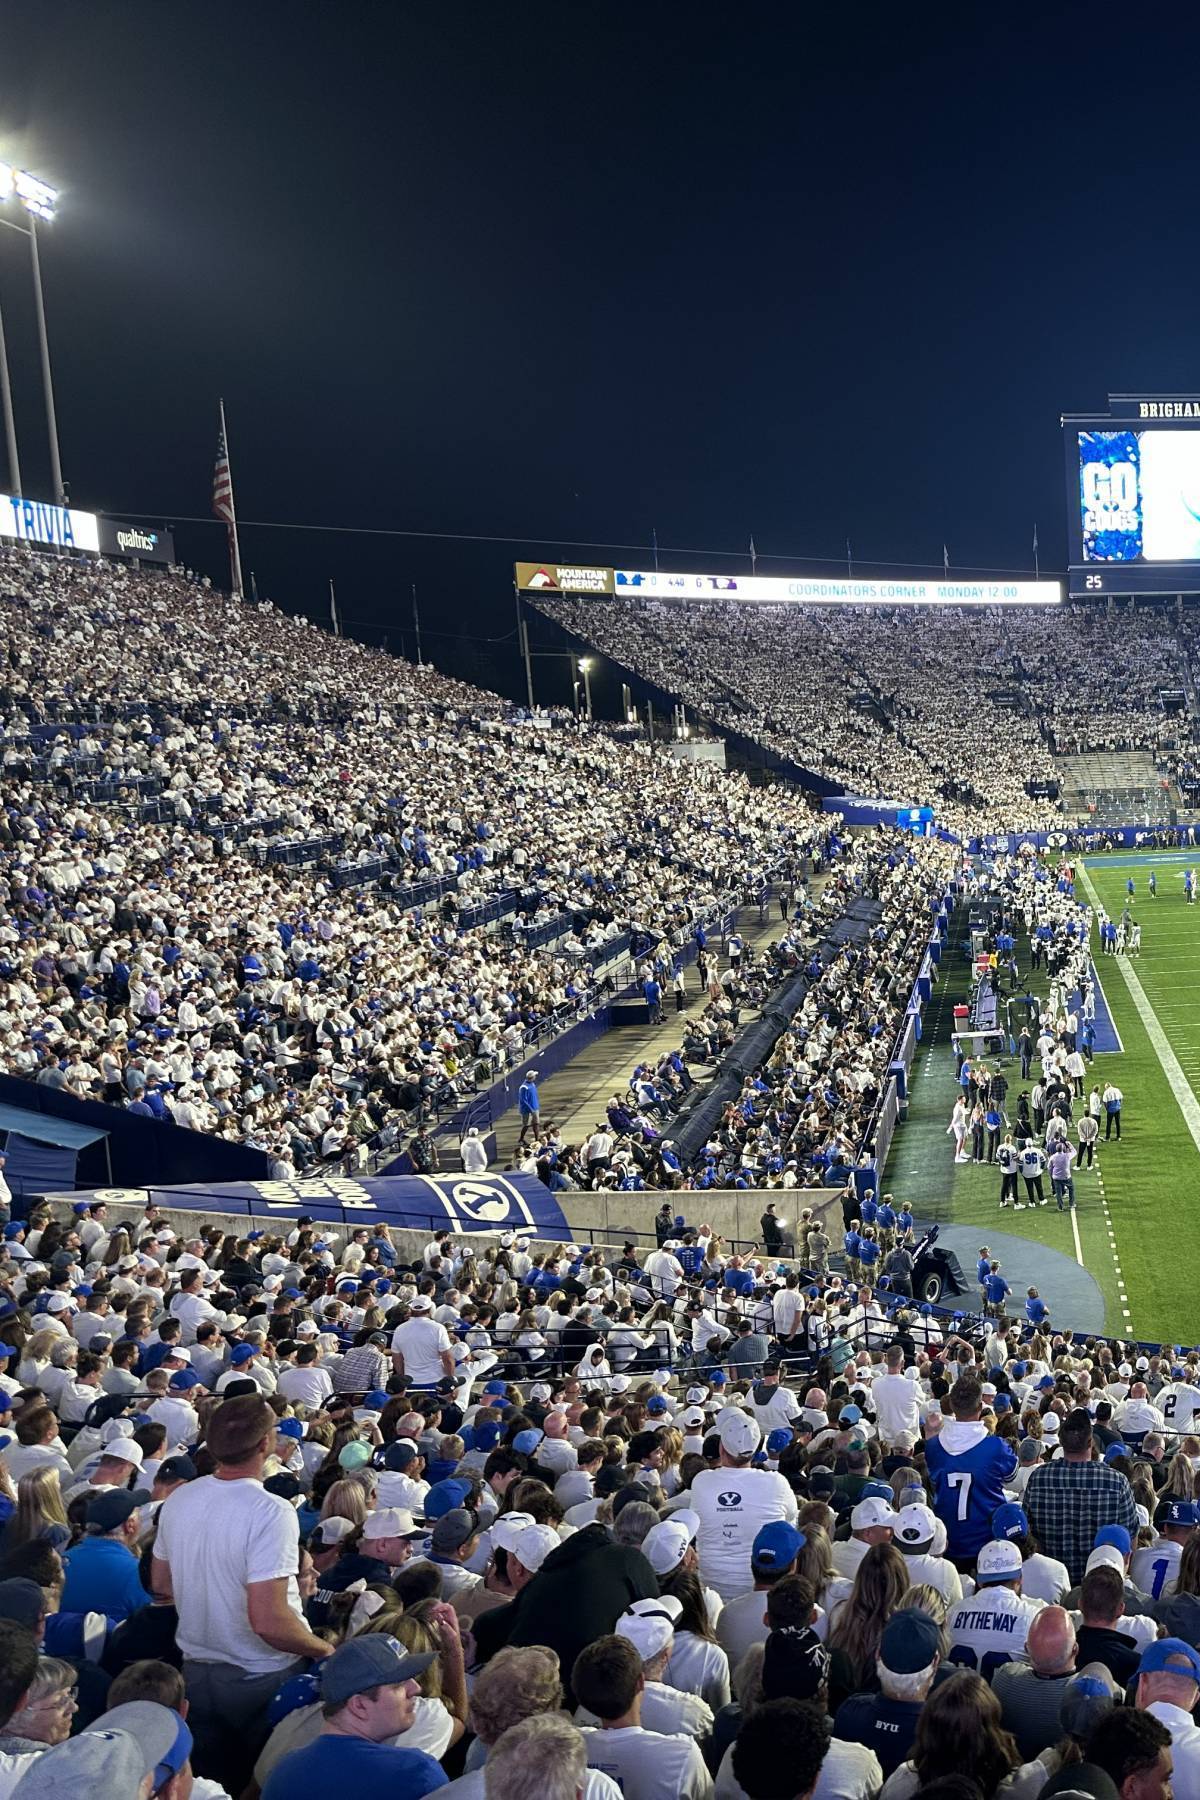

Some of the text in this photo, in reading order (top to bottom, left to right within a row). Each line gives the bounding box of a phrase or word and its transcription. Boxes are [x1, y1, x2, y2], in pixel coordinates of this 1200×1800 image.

[10, 497, 76, 548] TRIVIA
[117, 529, 154, 552] qualtrics
[556, 568, 608, 580] MOUNTAIN
[1086, 575, 1103, 589] 25
[560, 578, 606, 591] AMERICA
[788, 583, 877, 597] COORDINATORS
[880, 586, 927, 598] CORNER
[937, 586, 984, 598] MONDAY
[1164, 1394, 1177, 1418] 2
[721, 1493, 738, 1505] Y
[947, 1472, 972, 1521] 7
[1151, 1558, 1170, 1601] 1
[953, 1611, 1018, 1633] BYTHEWAY
[874, 1720, 900, 1733] BYU
